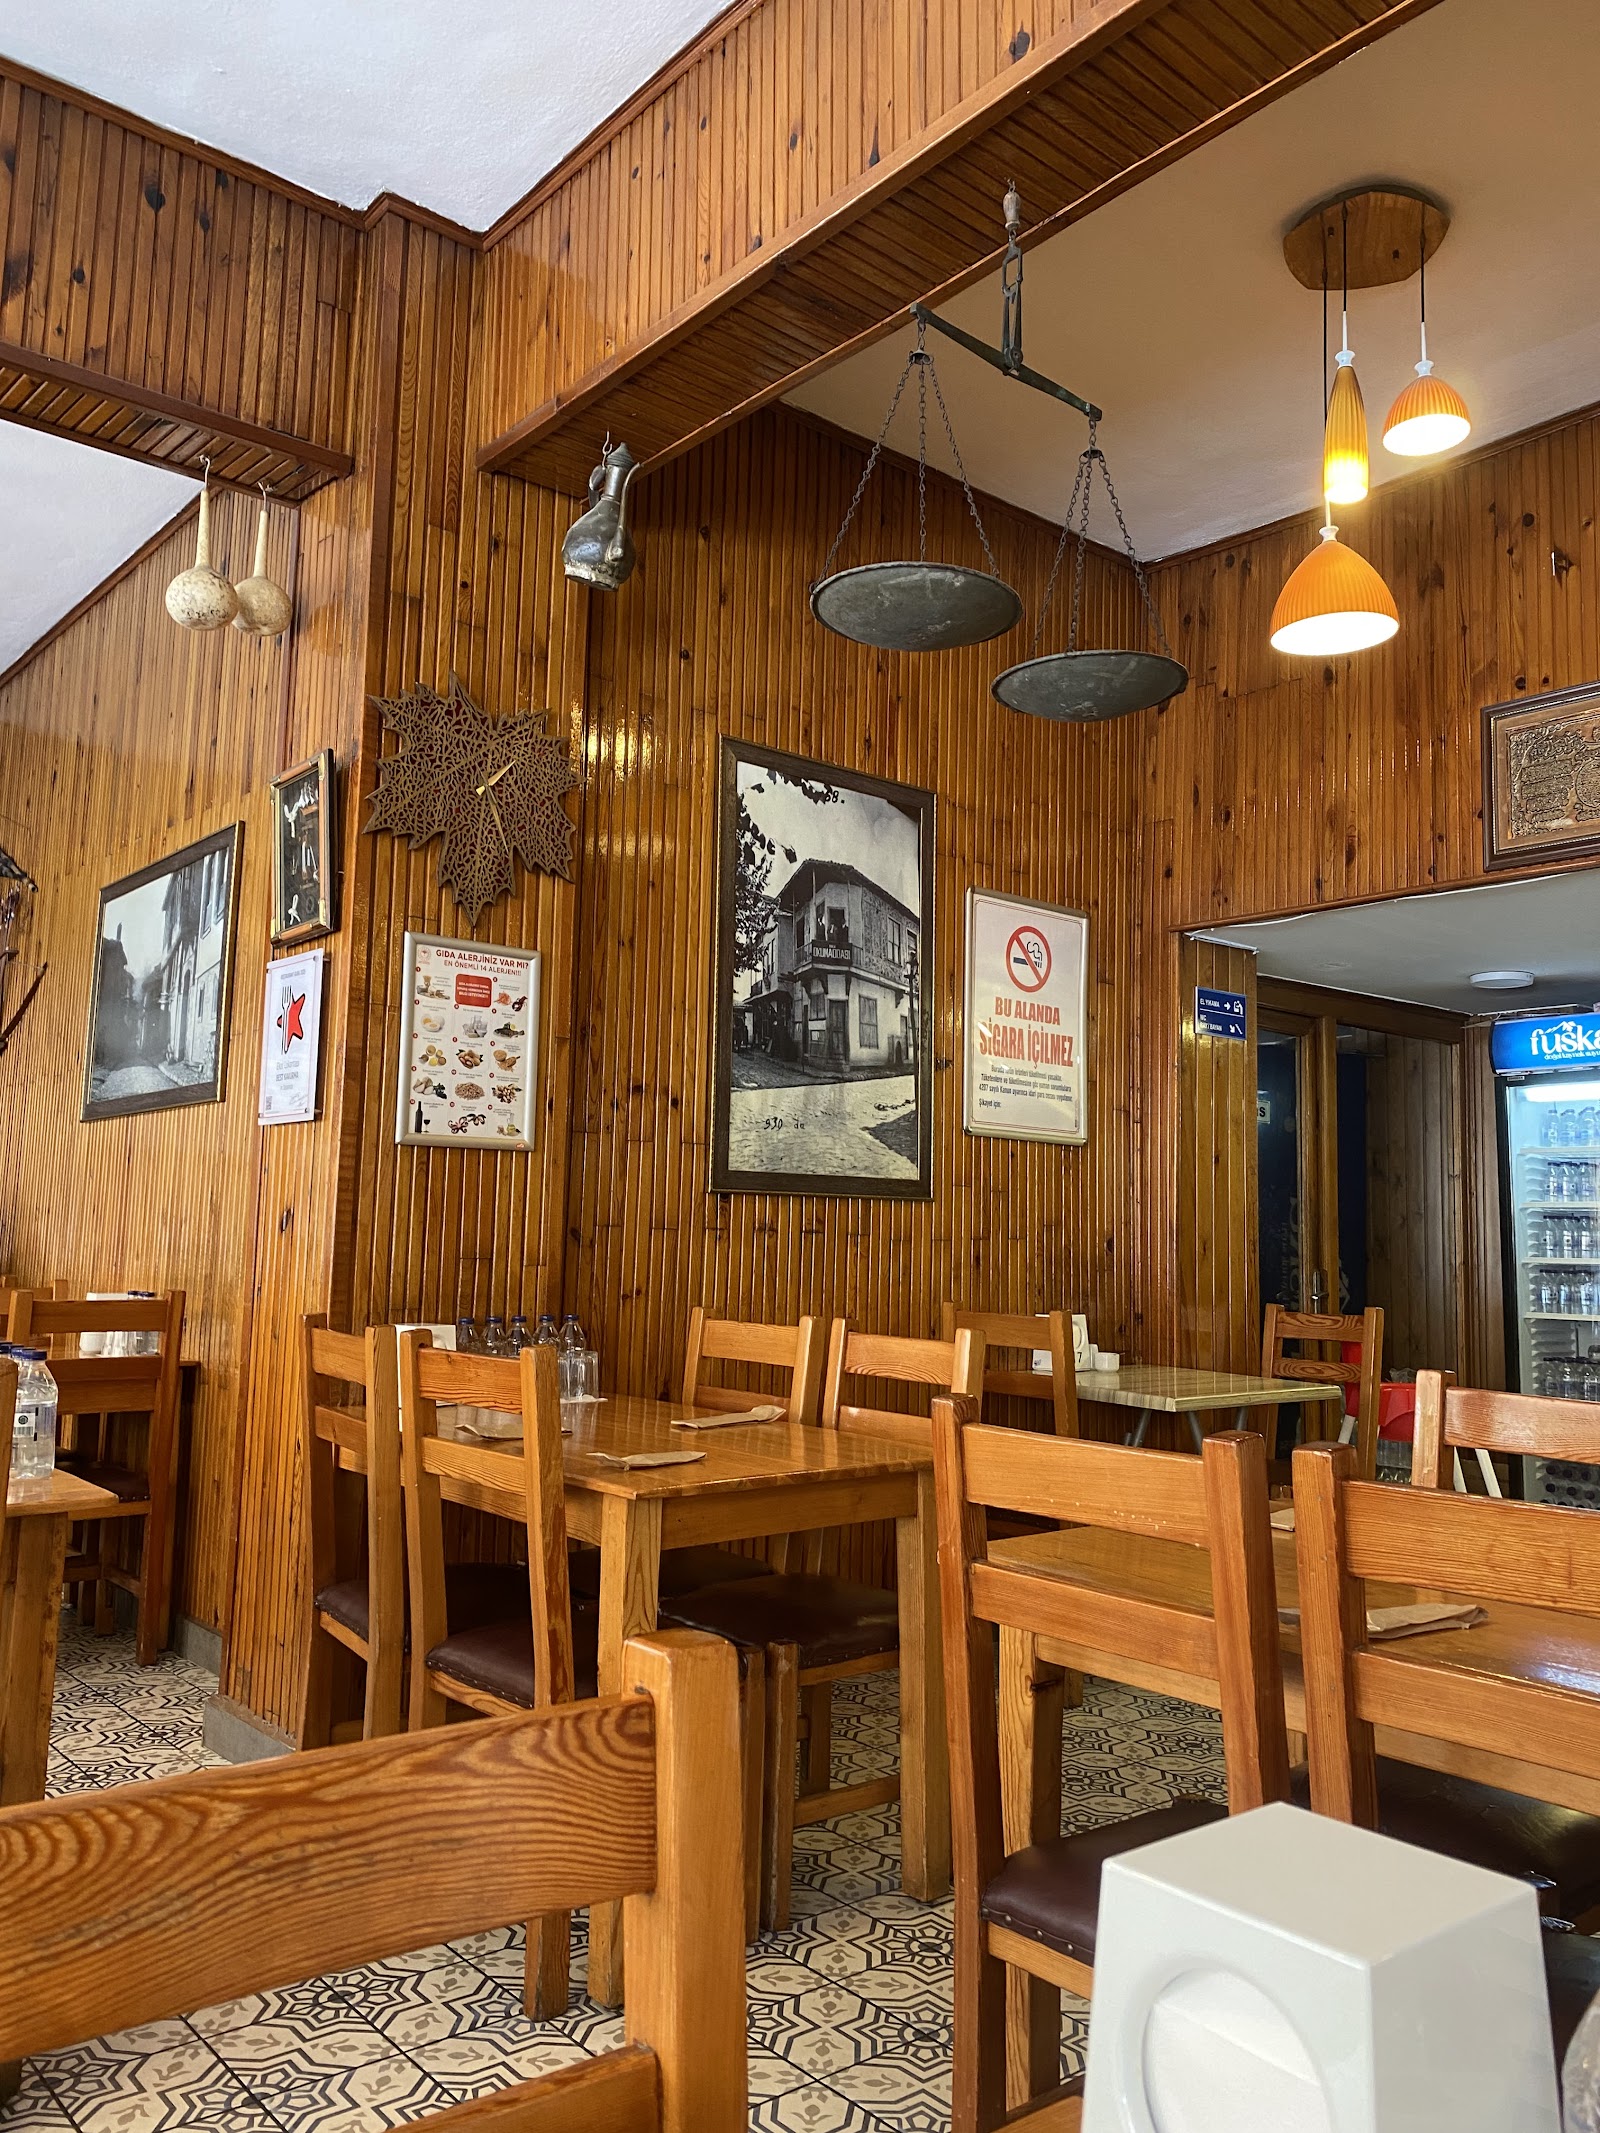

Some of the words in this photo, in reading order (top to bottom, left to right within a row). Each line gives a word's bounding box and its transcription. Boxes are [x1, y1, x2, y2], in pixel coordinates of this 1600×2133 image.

[436, 949, 455, 959] GIDA
[457, 952, 497, 966] ALERJİNİZ
[499, 958, 515, 967] VAR
[516, 960, 529, 970] MI?
[454, 960, 478, 970] ÖNEMLİ
[995, 996, 1012, 1017] BU
[1014, 1000, 1060, 1026] ALANDA
[979, 1017, 1025, 1060] SİGARA
[1027, 1024, 1073, 1069] İÇİLMEZ
